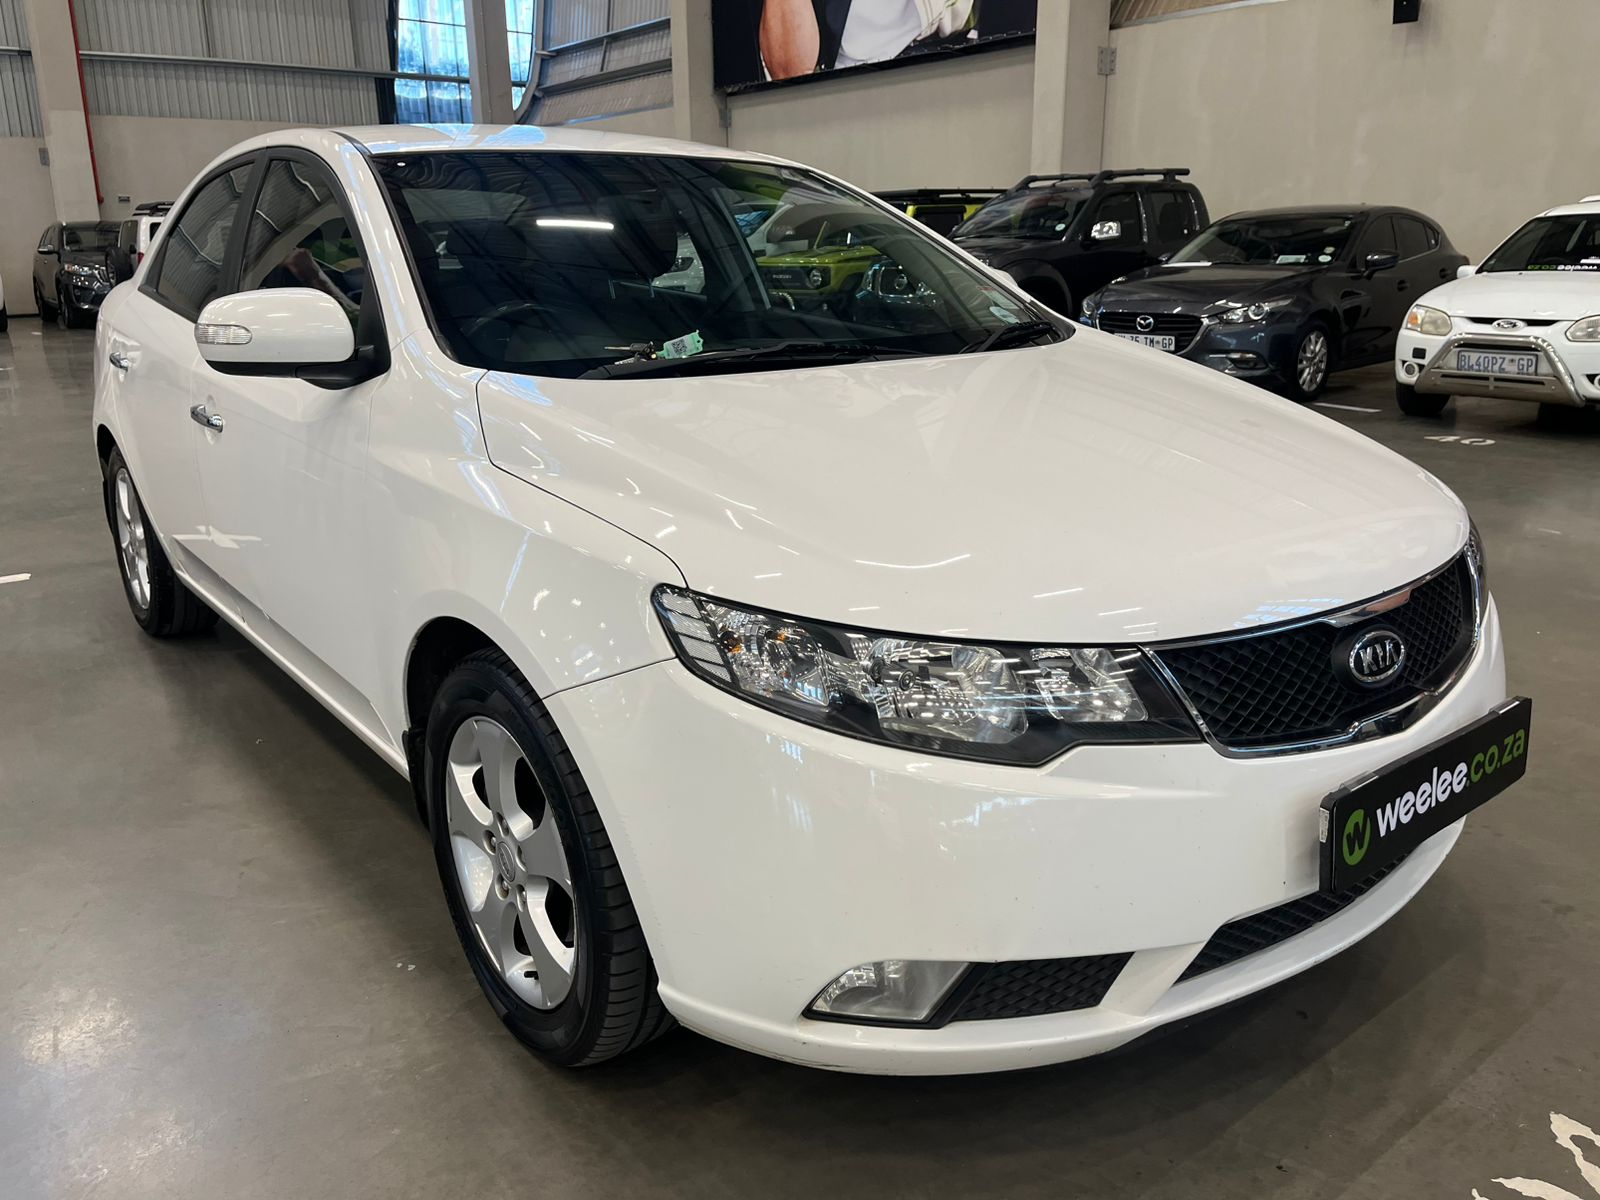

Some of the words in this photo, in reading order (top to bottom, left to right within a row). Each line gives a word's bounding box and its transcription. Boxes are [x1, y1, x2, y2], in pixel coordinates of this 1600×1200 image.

[1161, 337, 1174, 349] GP
[1517, 357, 1533, 373] GP
[1376, 729, 1525, 837] weelee.co.za
